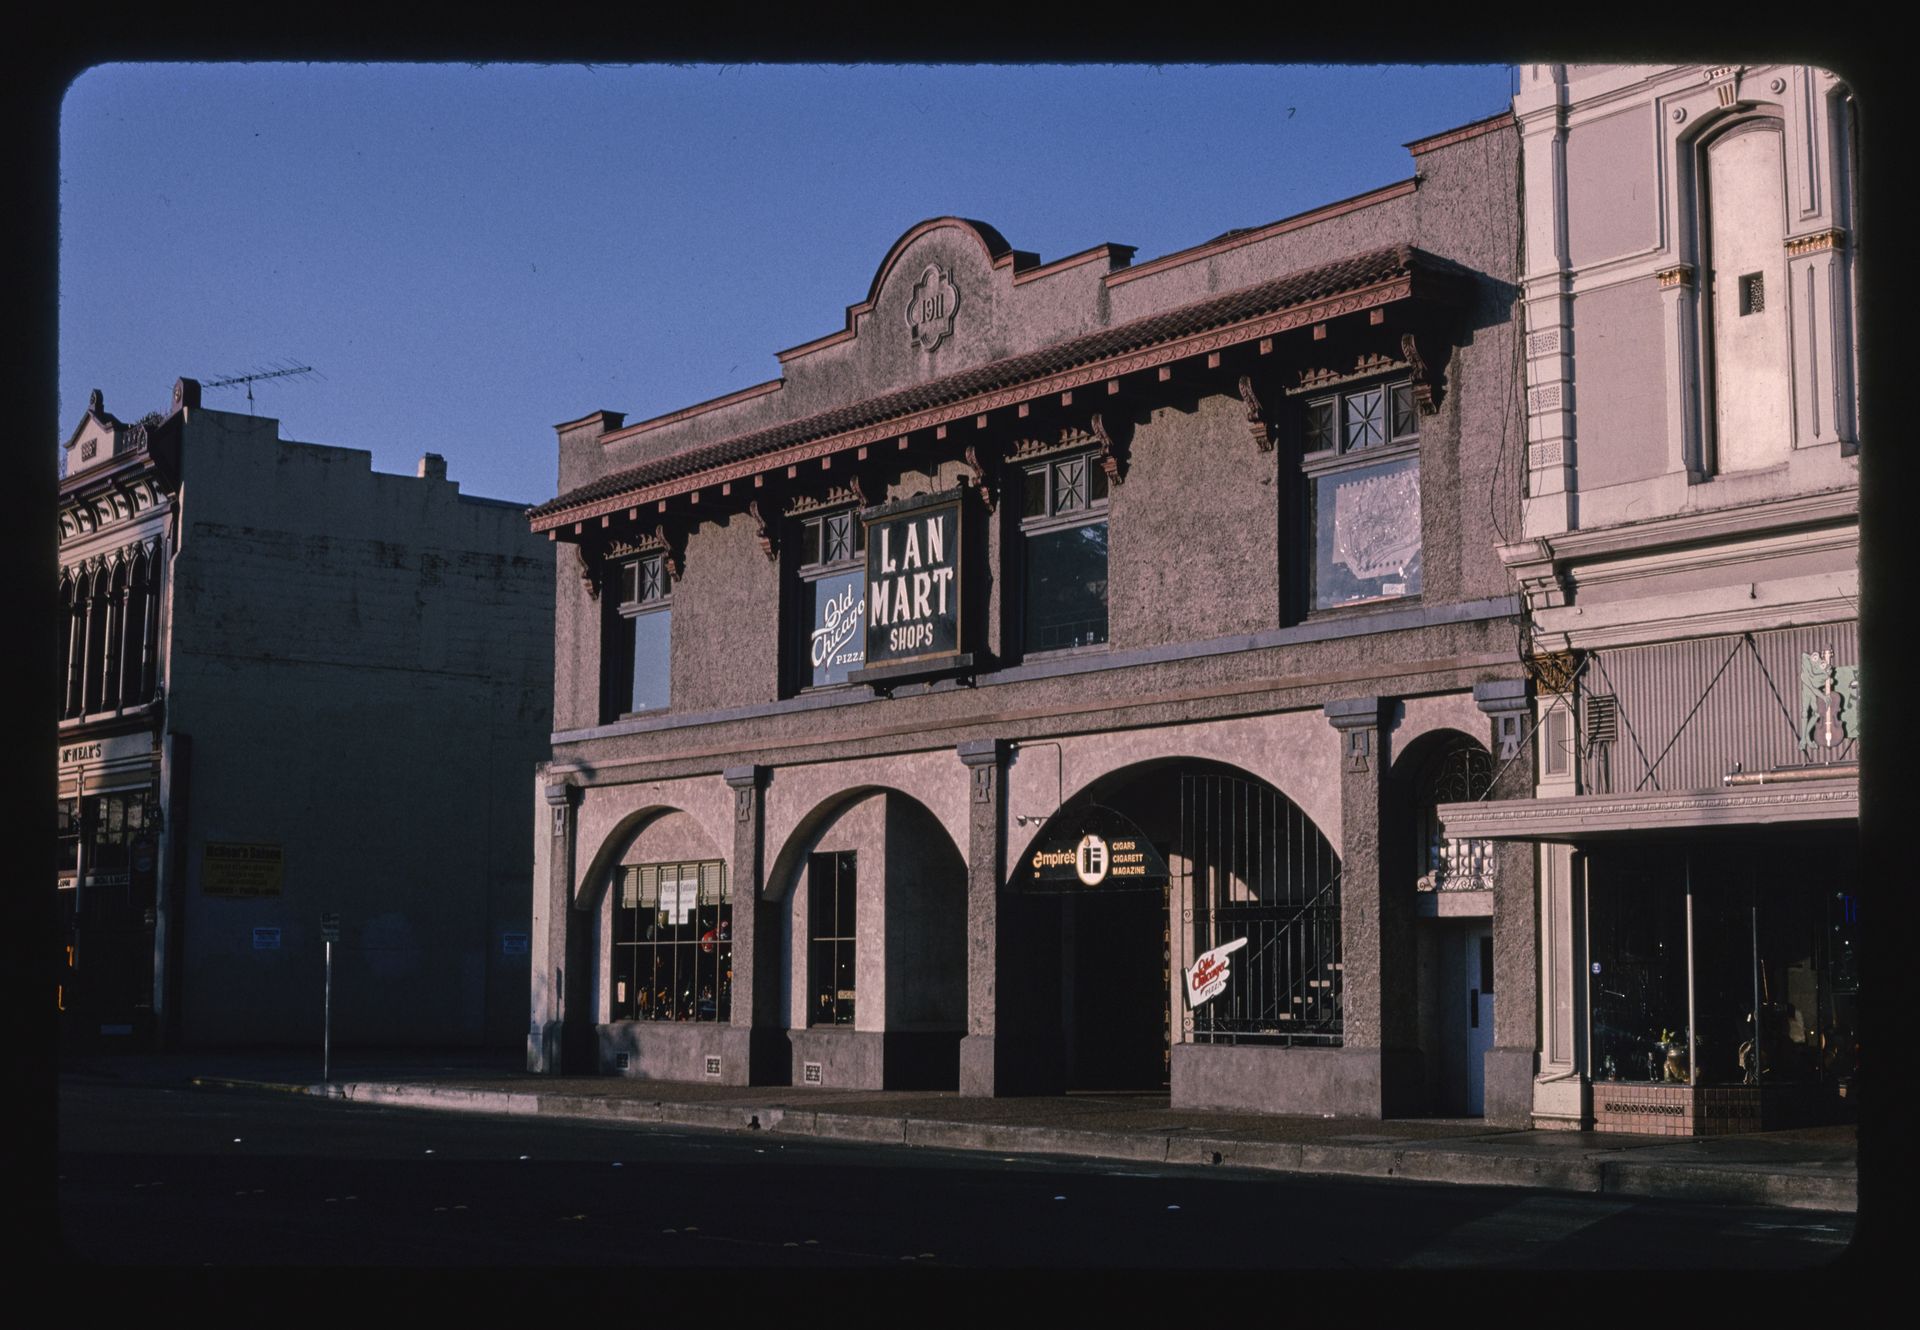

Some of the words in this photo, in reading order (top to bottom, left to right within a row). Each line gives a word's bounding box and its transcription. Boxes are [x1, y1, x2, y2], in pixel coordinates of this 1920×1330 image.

[921, 294, 944, 324] 1911
[881, 515, 944, 575] LAN
[825, 584, 854, 627] Old
[870, 566, 954, 627] MART
[811, 600, 865, 668] Chicago
[890, 622, 934, 651] SHOPS
[1032, 849, 1076, 869] empire's
[1112, 841, 1136, 851] CIGARS
[1112, 854, 1144, 863] CIGARETT
[1112, 866, 1146, 876] MAGAZINE
[1198, 954, 1215, 974] Old
